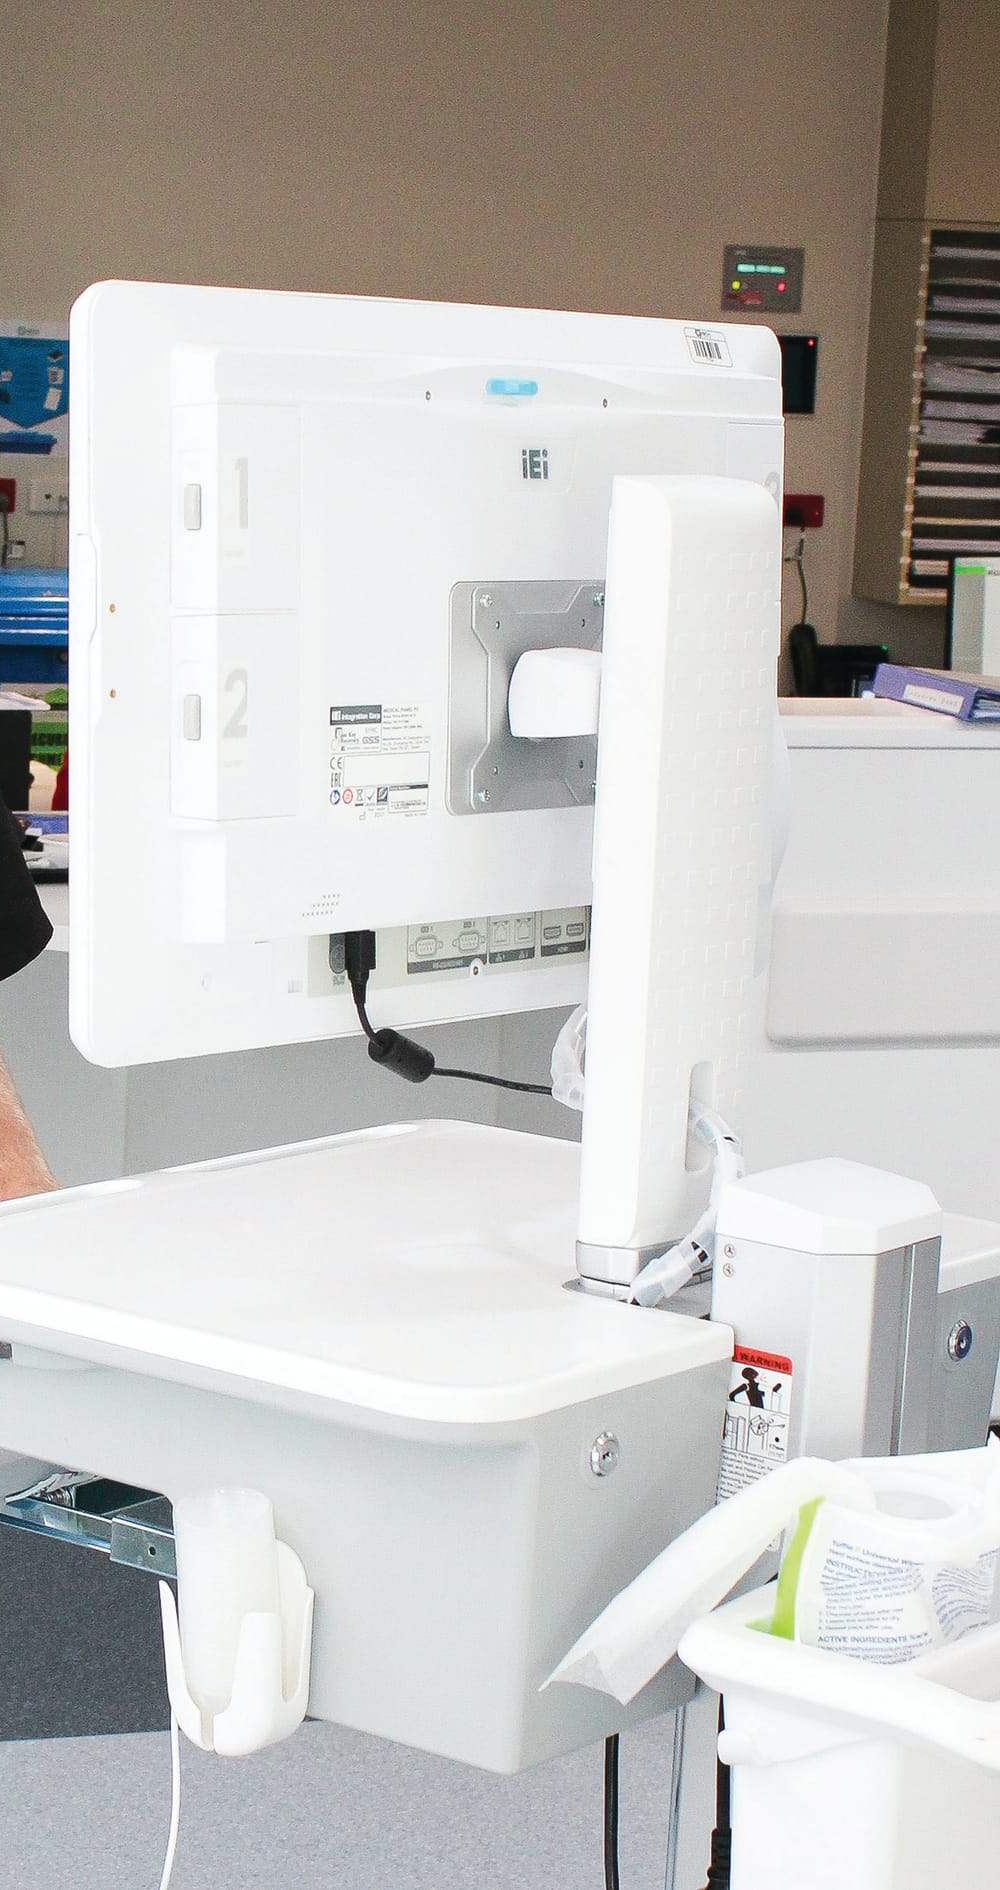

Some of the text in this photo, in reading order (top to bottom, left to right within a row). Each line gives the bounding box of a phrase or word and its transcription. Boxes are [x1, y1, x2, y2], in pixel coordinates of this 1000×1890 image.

[234, 457, 249, 529] 1
[223, 668, 249, 739] 2
[741, 1353, 789, 1371] WARNING
[862, 1548, 900, 1563] Universal
[818, 1635, 849, 1643] ACTIVE
[850, 1635, 908, 1644] INGREDIENTS
